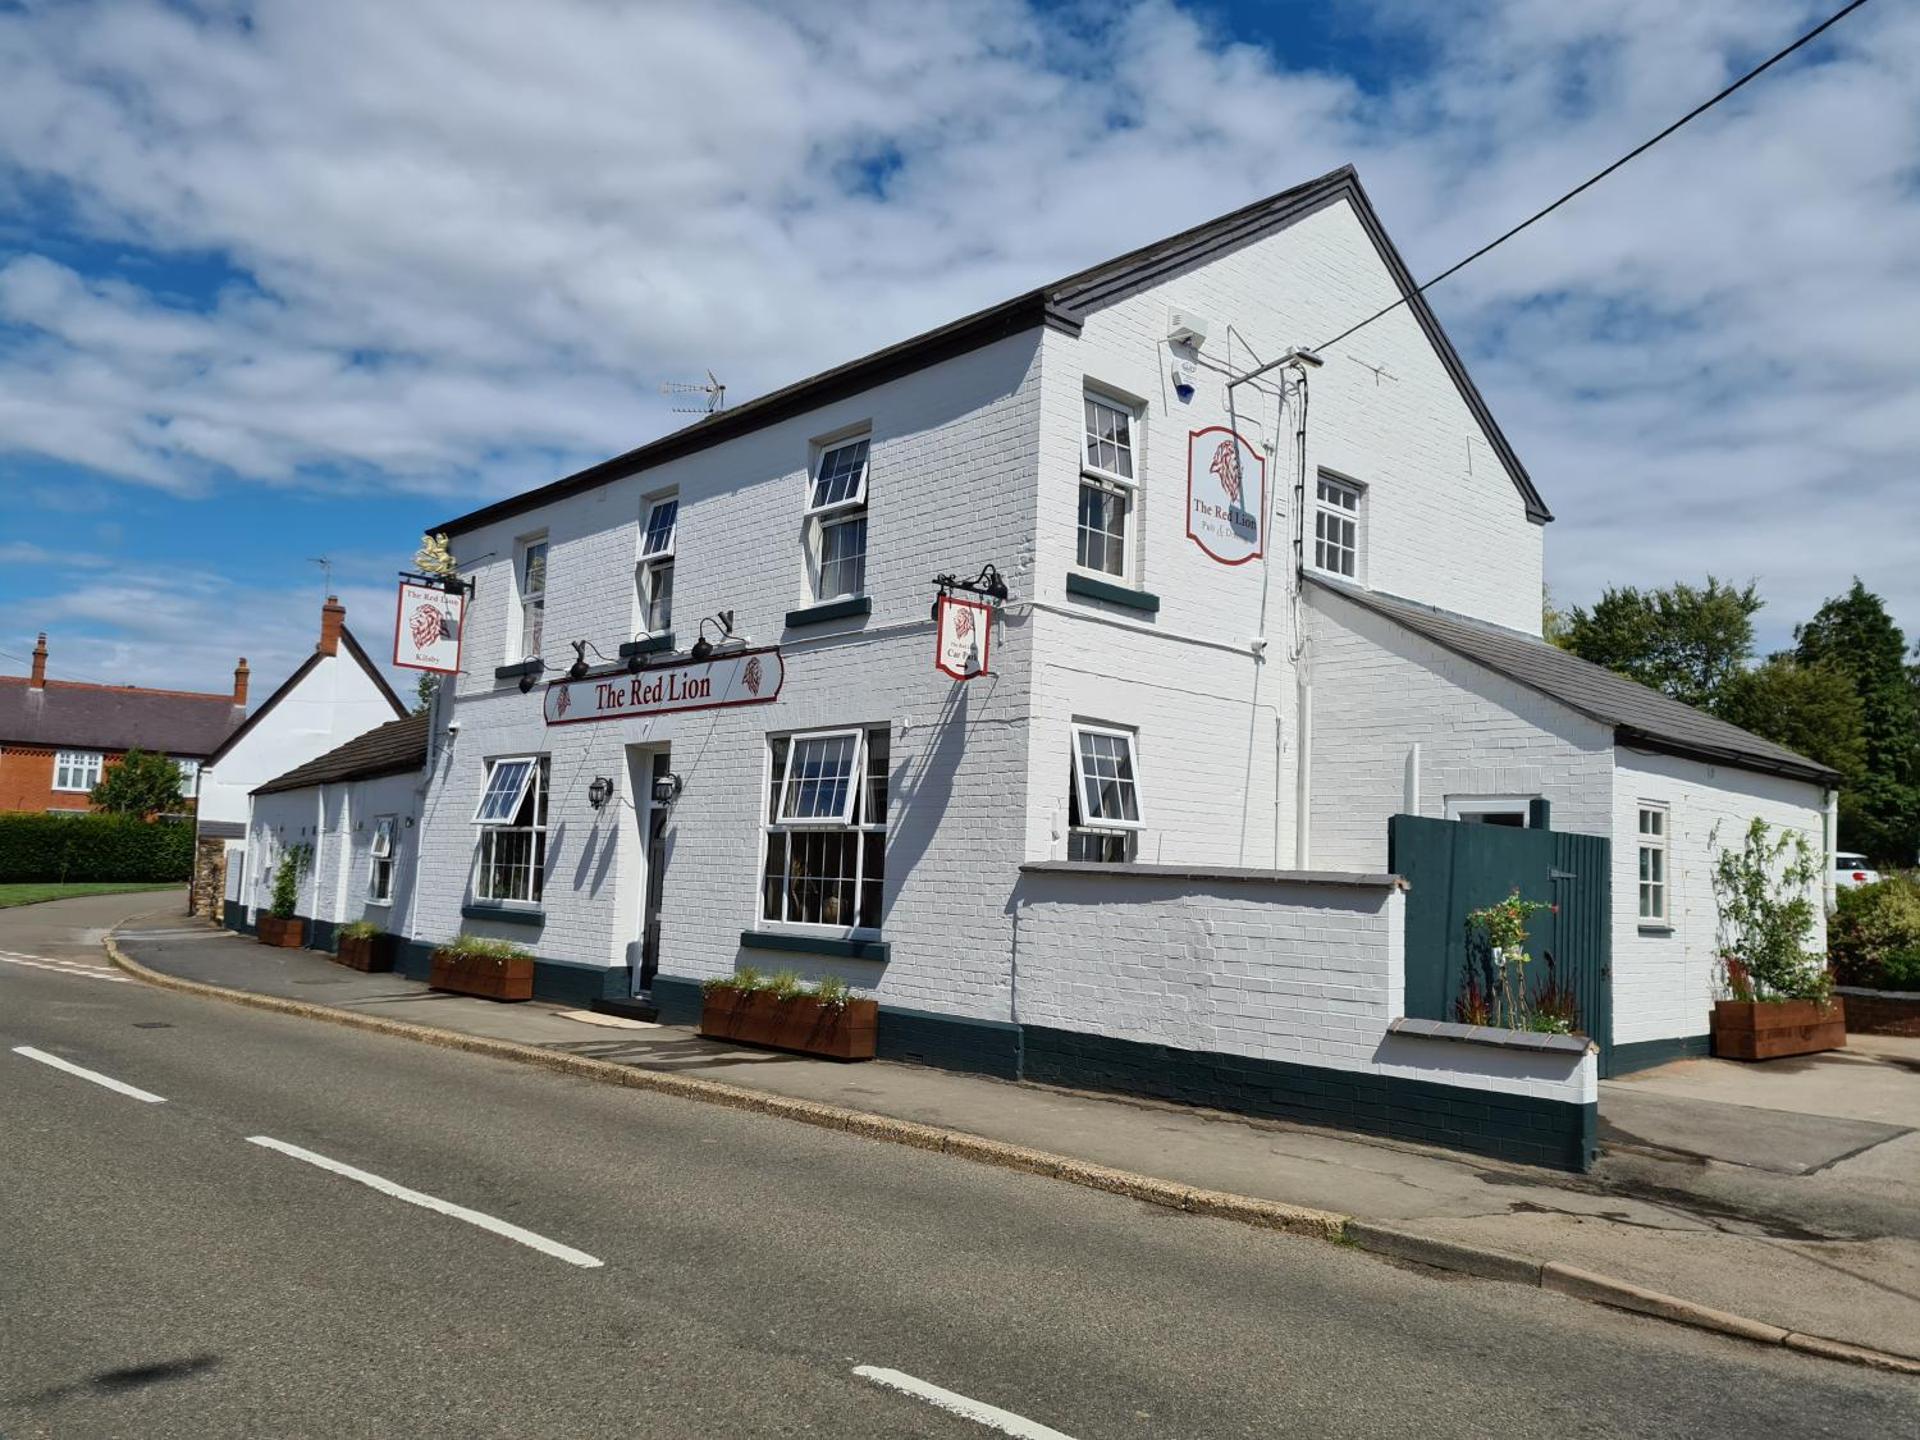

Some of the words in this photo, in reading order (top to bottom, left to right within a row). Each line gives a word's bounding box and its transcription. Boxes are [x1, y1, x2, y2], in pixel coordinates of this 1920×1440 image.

[1194, 498, 1213, 515] The
[1215, 505, 1233, 521] Red
[1236, 512, 1257, 530] Lion
[407, 590, 422, 599] The
[424, 593, 439, 602] Red
[596, 683, 625, 710] The
[630, 677, 663, 706] Red
[668, 672, 711, 701] Lion
